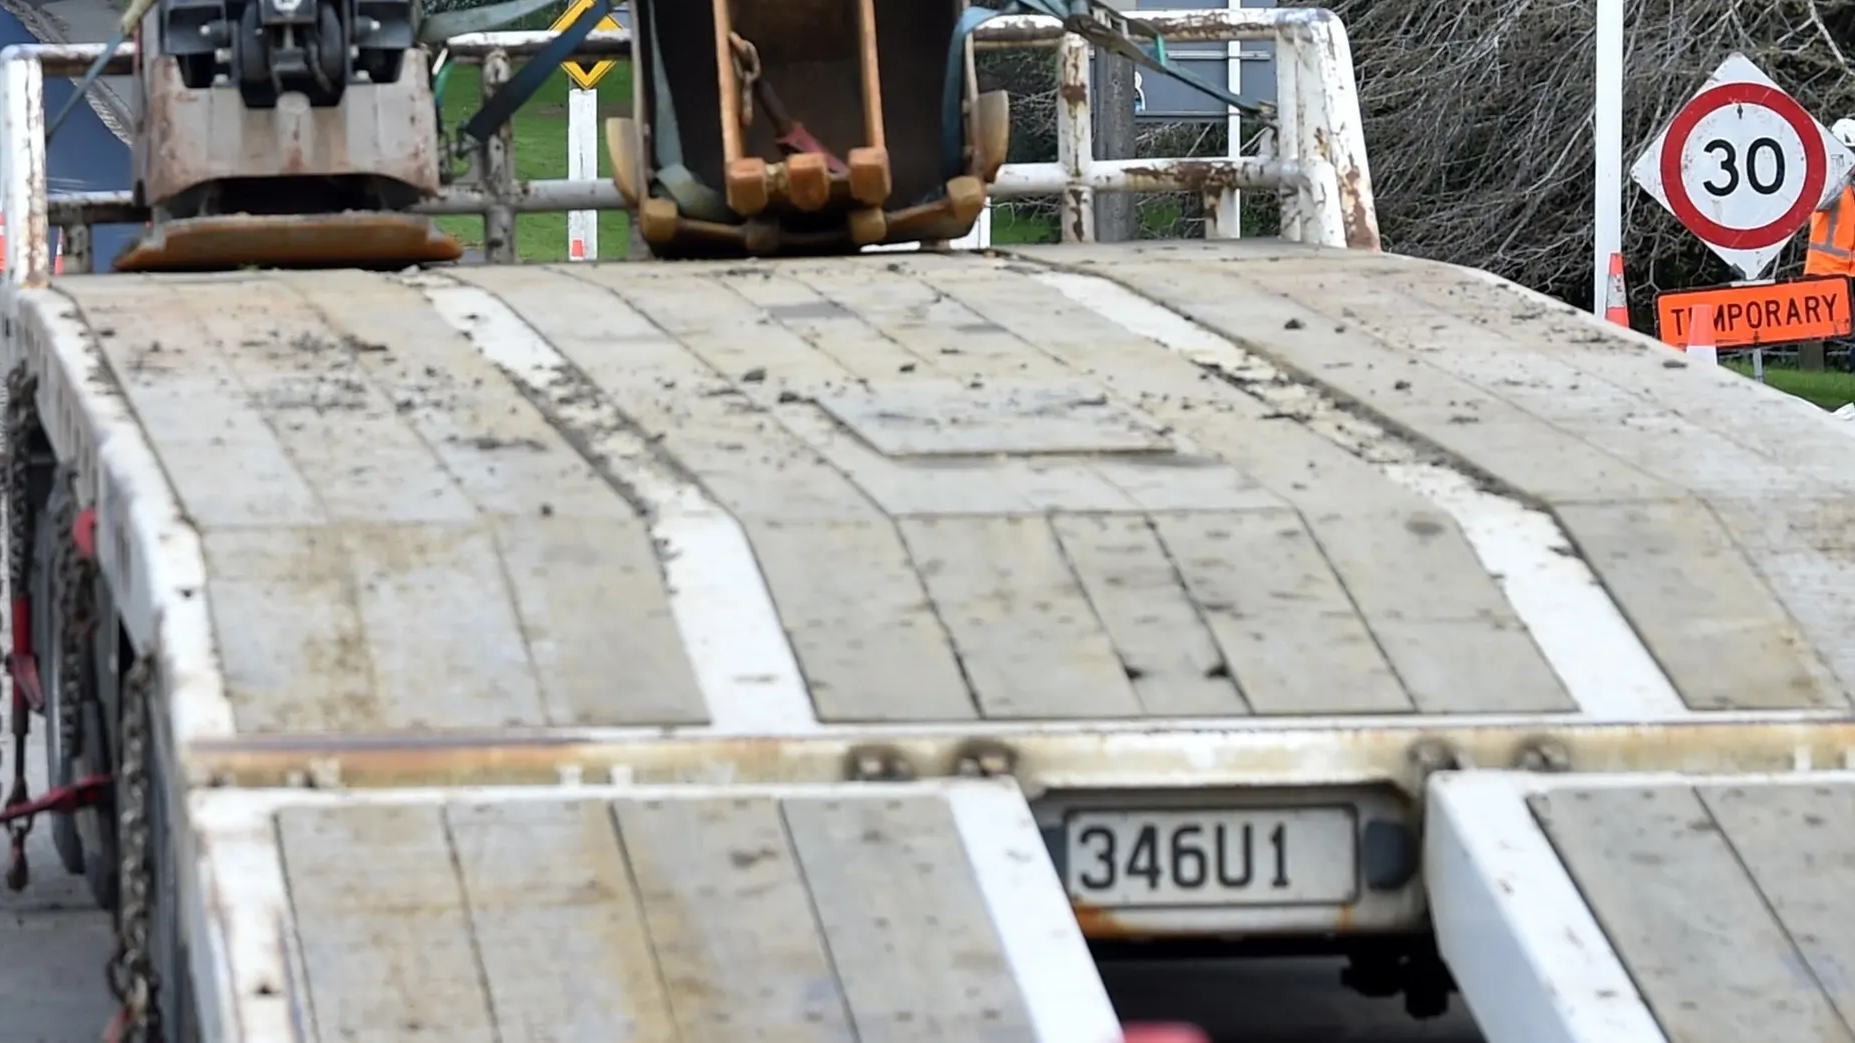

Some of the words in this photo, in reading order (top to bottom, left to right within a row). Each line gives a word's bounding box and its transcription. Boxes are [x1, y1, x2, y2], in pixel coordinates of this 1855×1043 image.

[1703, 137, 1785, 197] 30
[1670, 293, 1838, 336] TMPORARY
[1078, 822, 1292, 893] 346U1
